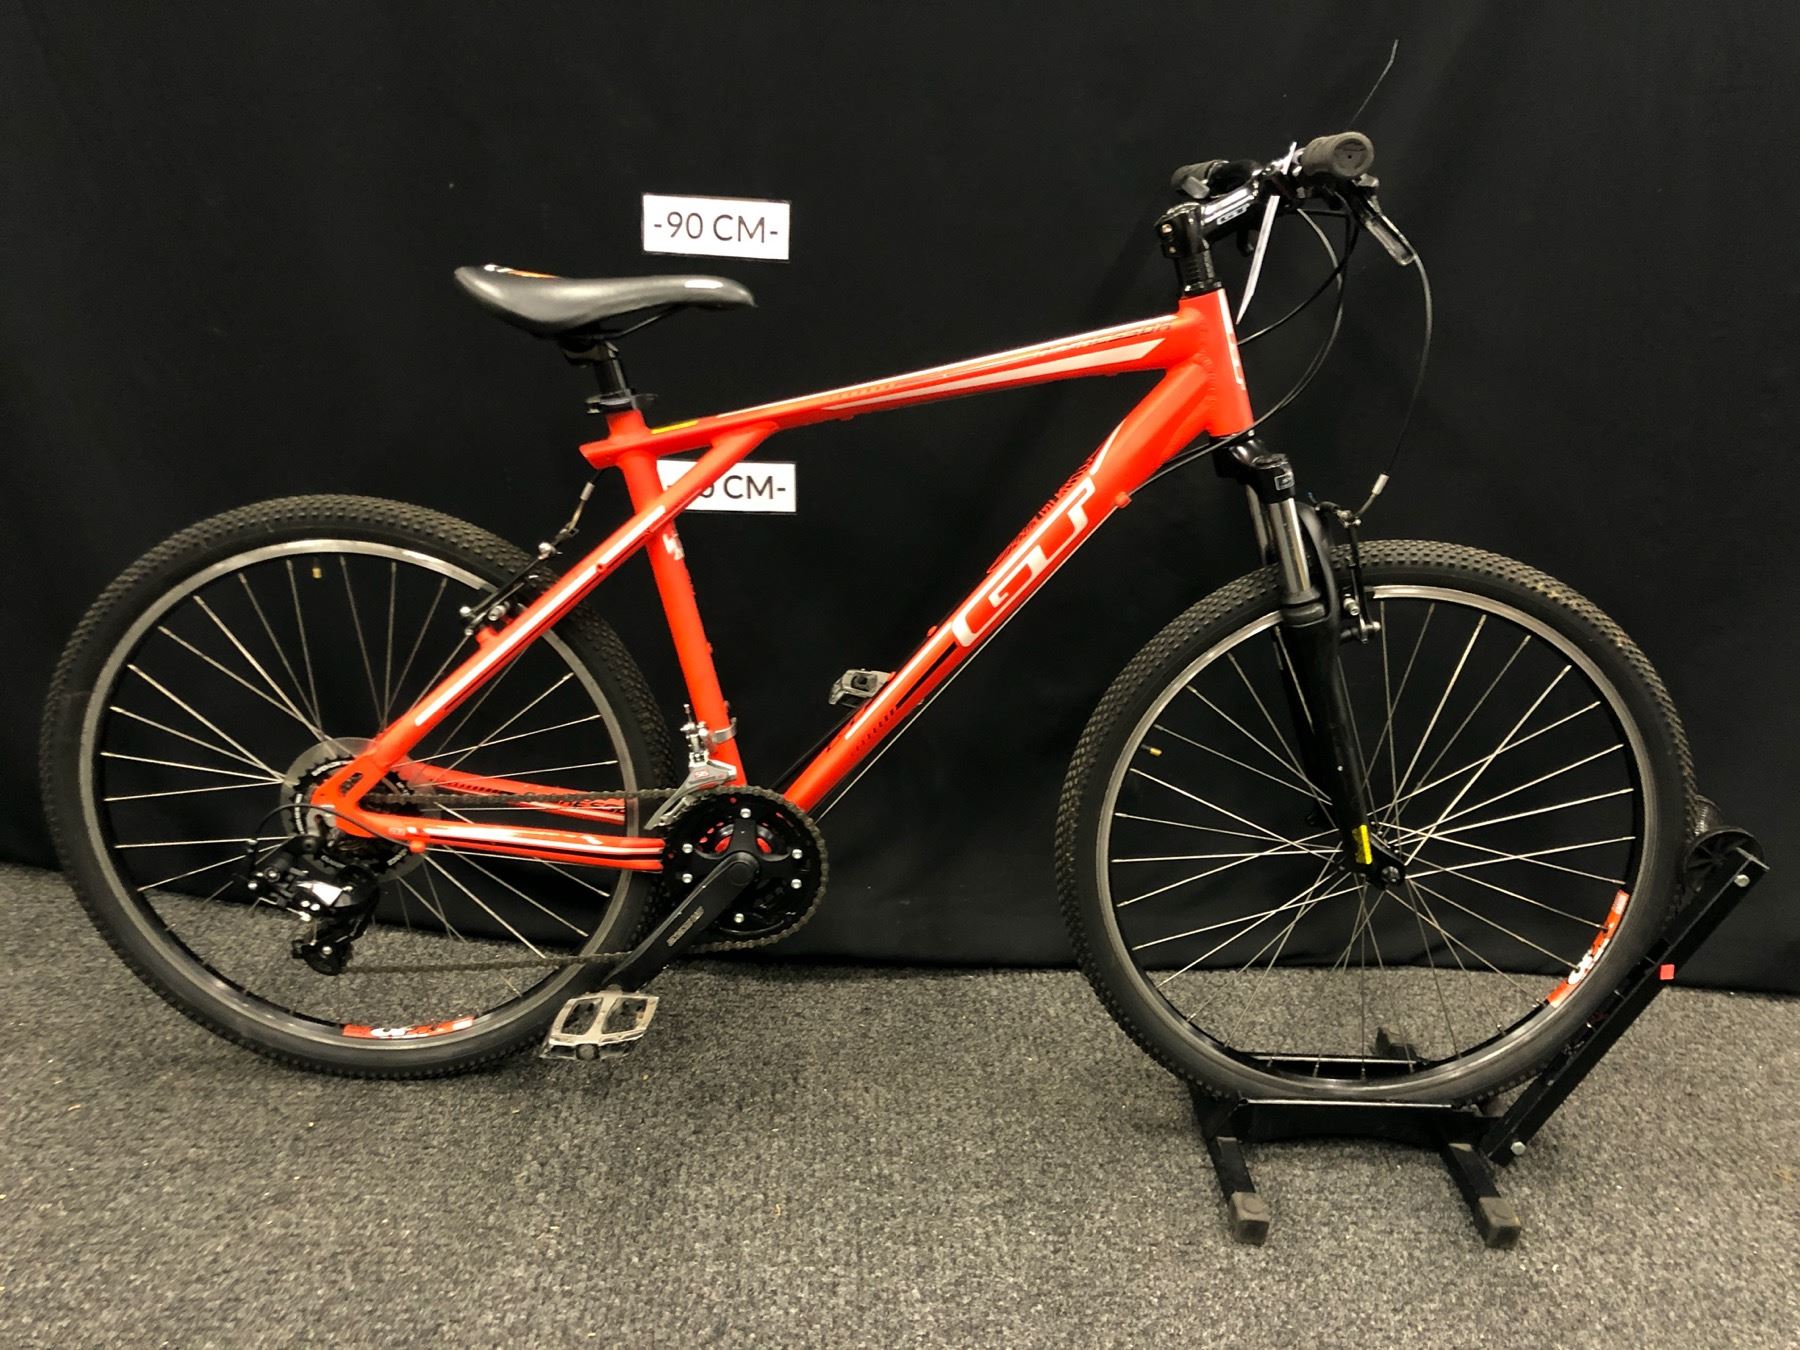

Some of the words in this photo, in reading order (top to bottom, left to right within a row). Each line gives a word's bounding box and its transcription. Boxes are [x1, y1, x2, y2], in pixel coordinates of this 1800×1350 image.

[653, 211, 703, 239] -90
[713, 214, 778, 244] CM-
[723, 475, 786, 500] CM-
[951, 476, 1096, 648] GT
